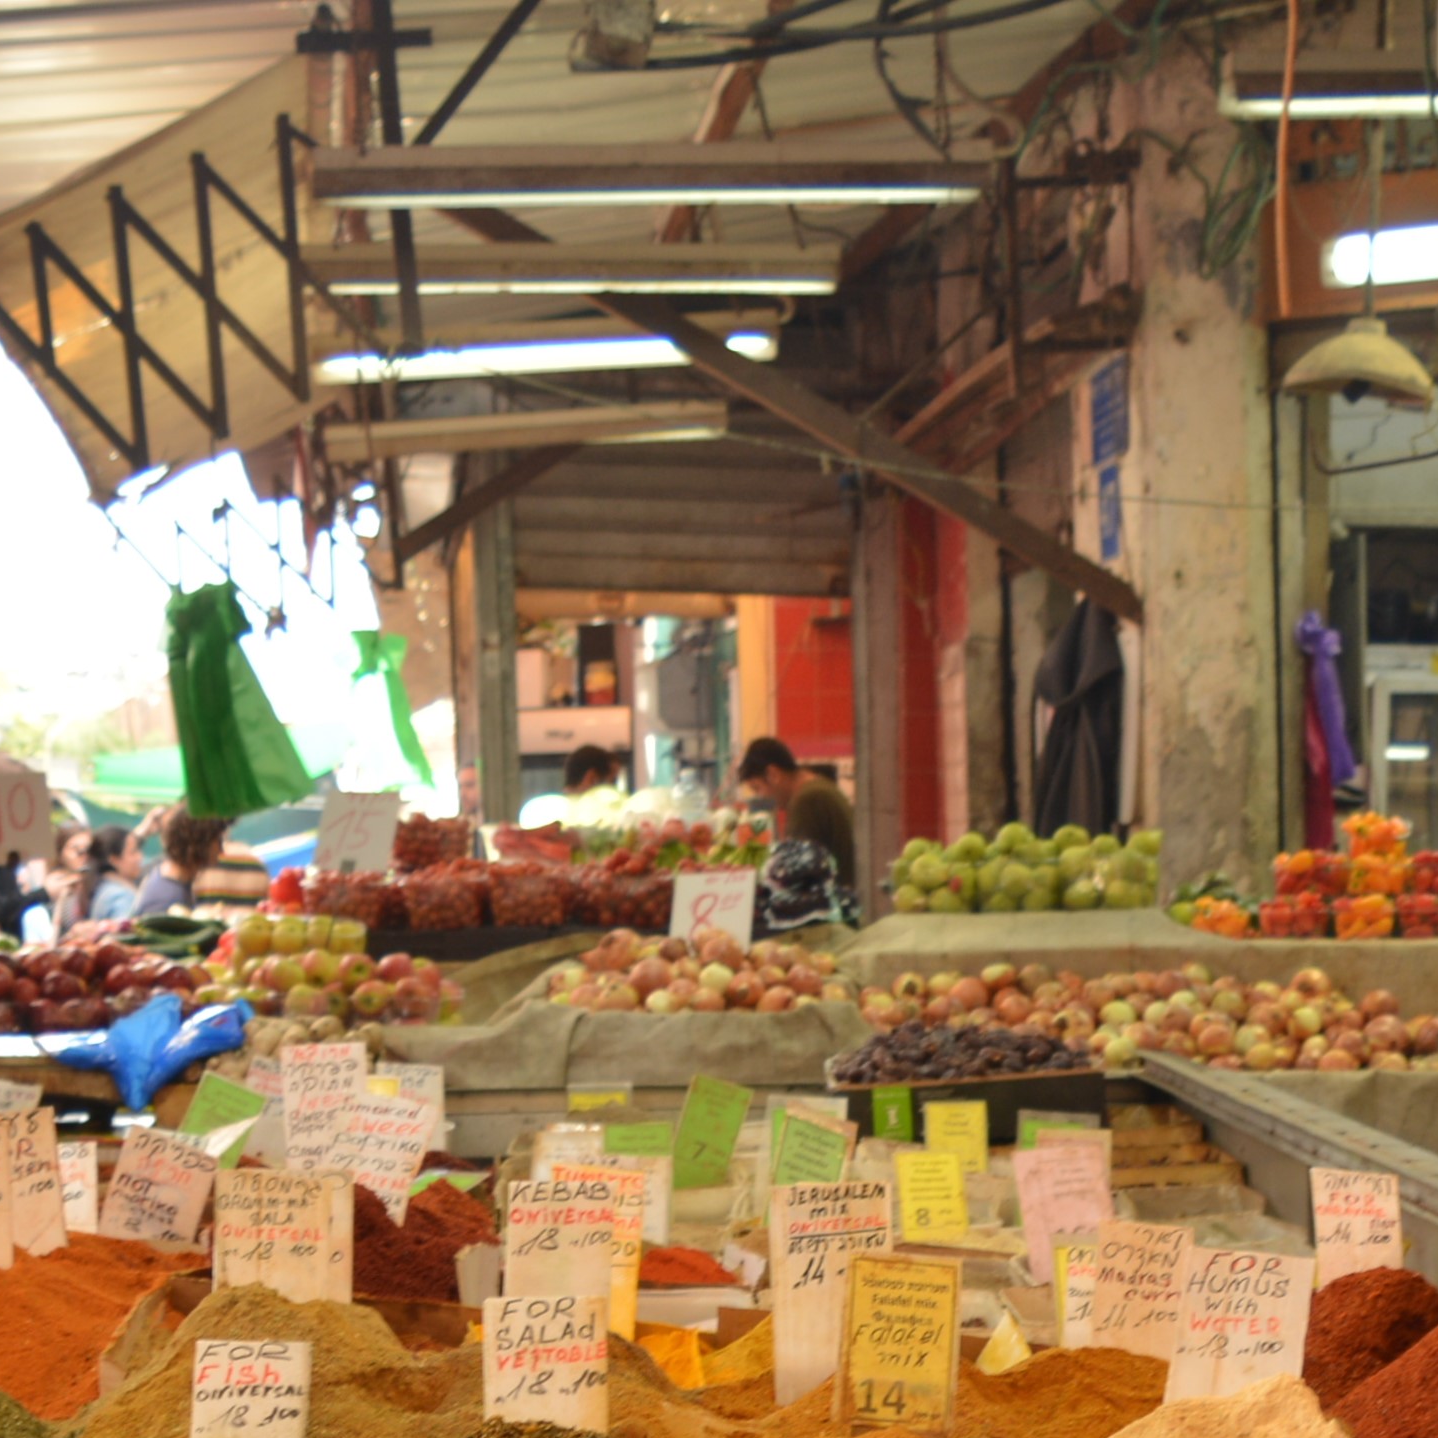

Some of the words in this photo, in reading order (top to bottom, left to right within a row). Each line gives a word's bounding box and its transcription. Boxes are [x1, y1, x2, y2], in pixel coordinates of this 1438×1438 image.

[511, 1182, 610, 1203] KEBAB
[788, 1184, 885, 1206] JERUSALEM
[1205, 1252, 1284, 1277] FOR
[1187, 1272, 1291, 1298] HUMUS
[500, 1297, 576, 1323] FOR
[852, 1323, 944, 1346] Falafel
[198, 1342, 294, 1364] FOR
[877, 1346, 930, 1368] mix
[856, 1378, 907, 1416] 14
